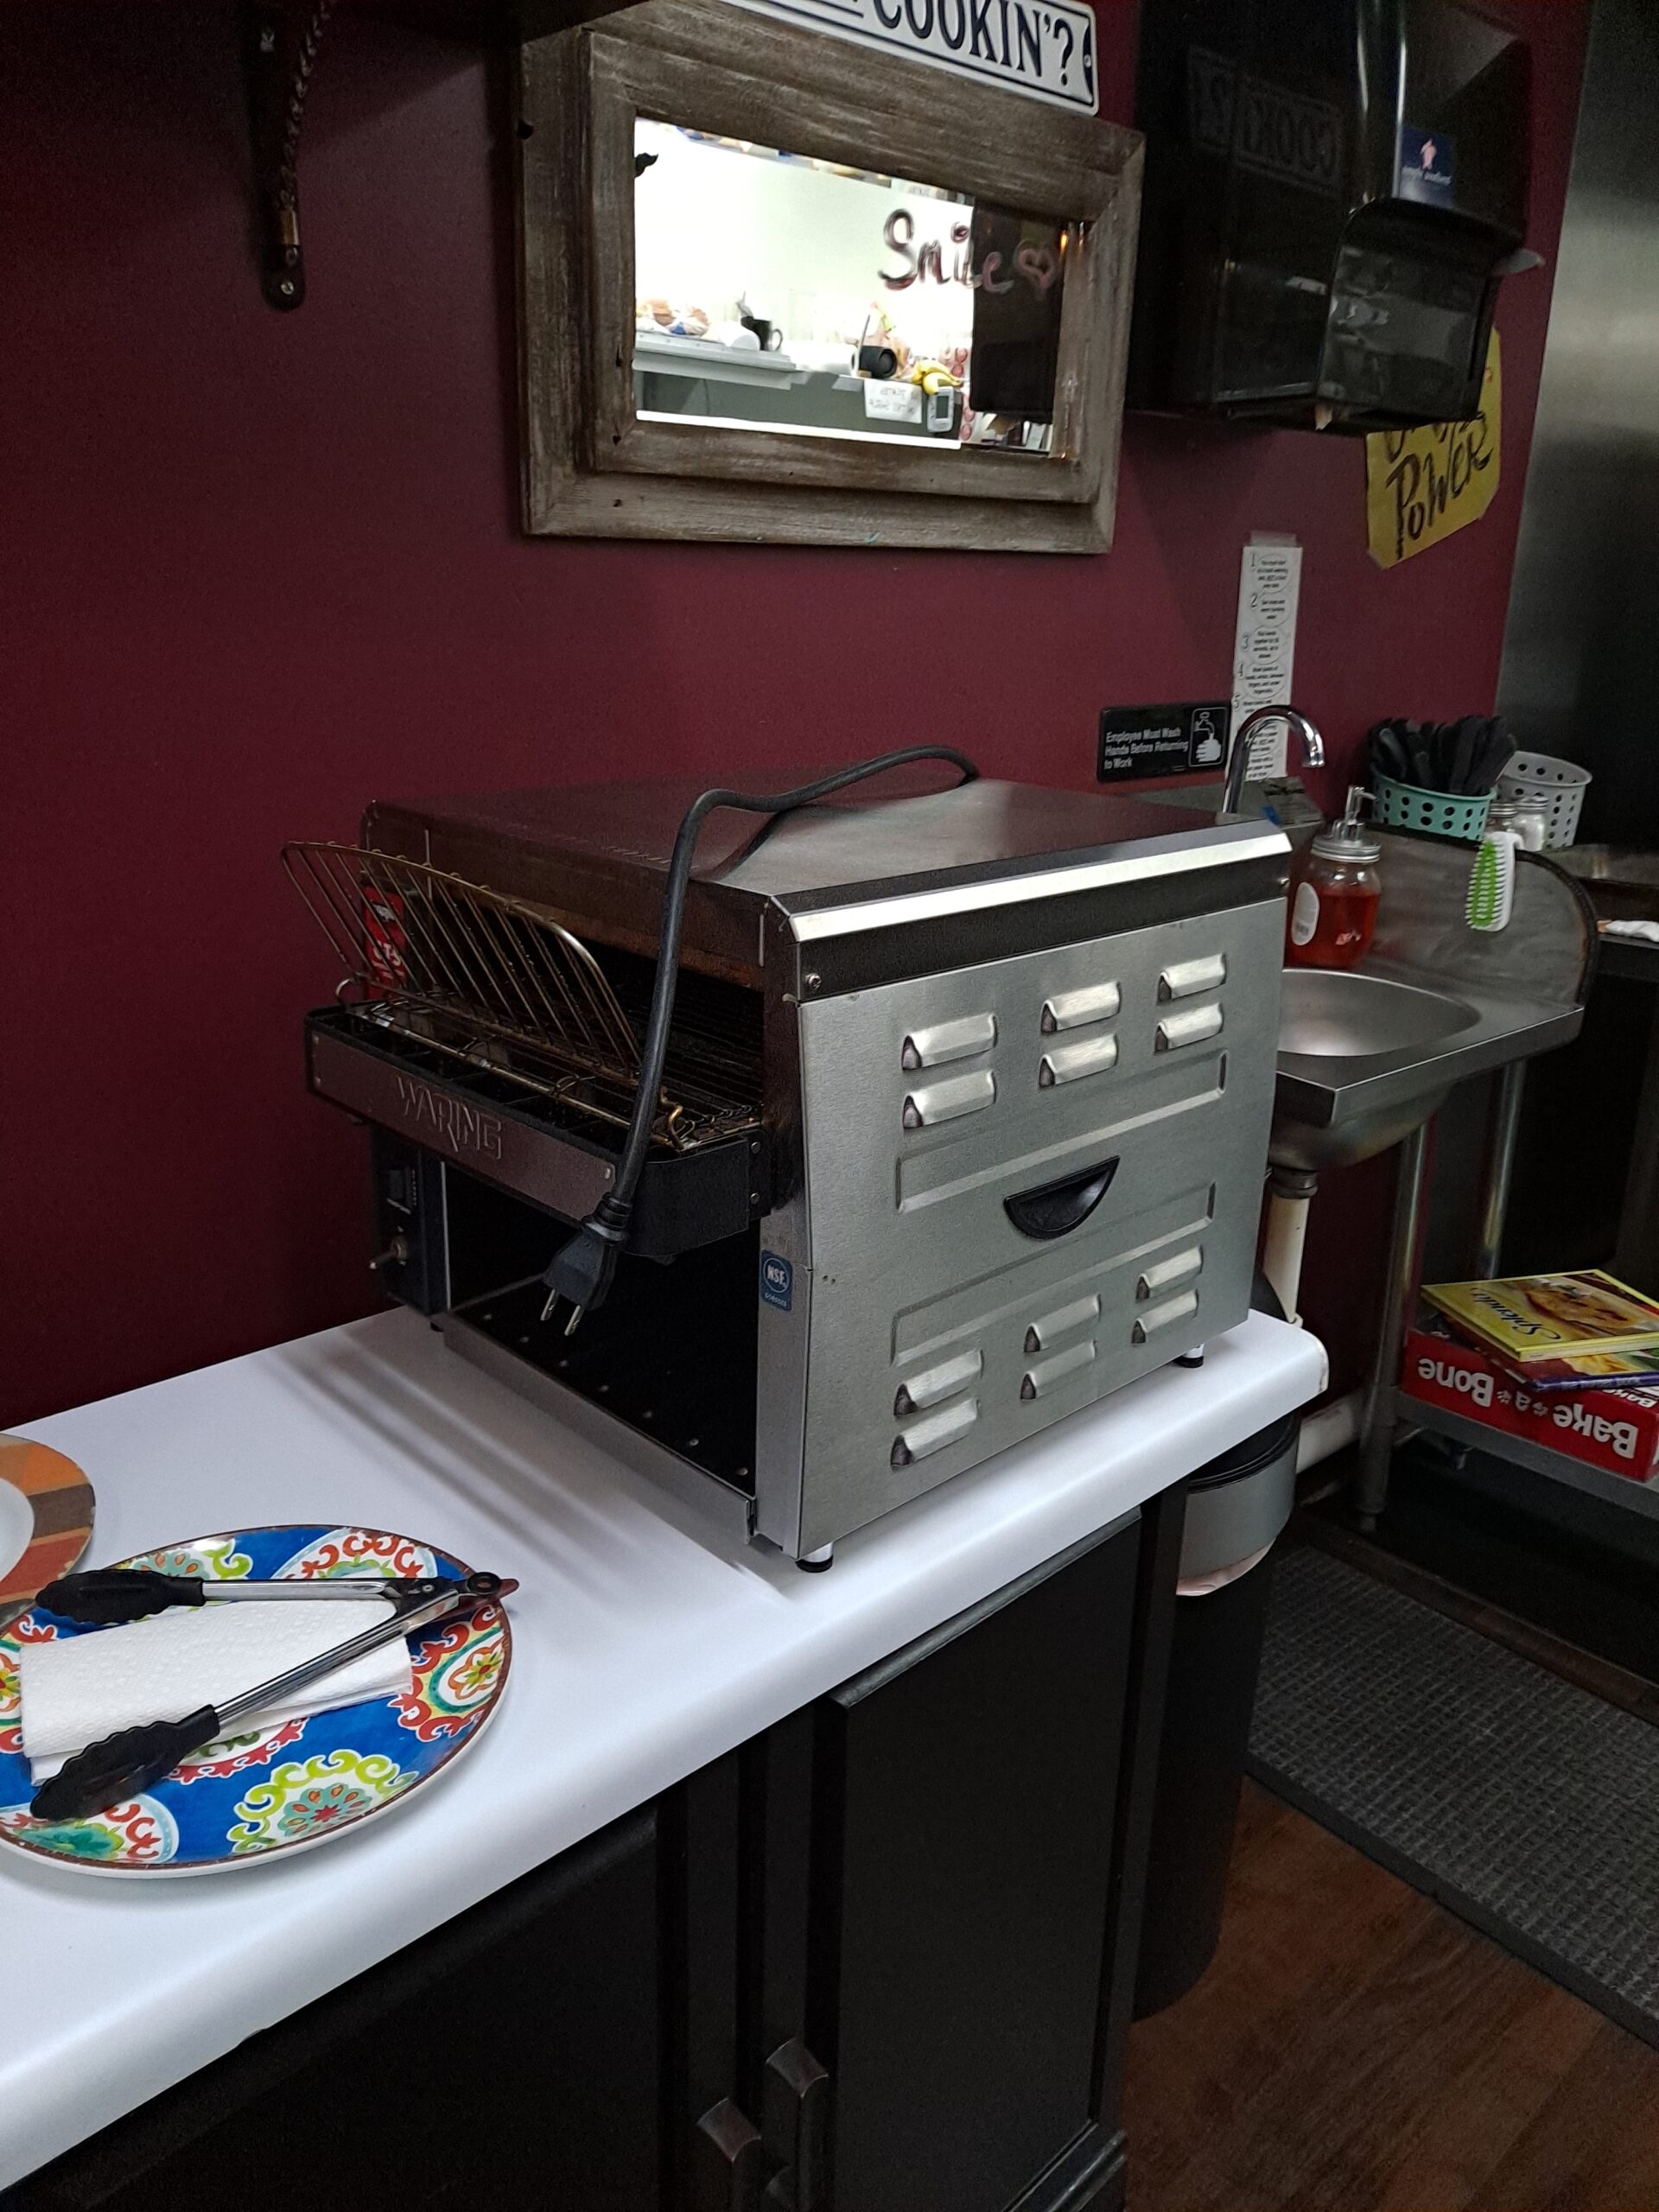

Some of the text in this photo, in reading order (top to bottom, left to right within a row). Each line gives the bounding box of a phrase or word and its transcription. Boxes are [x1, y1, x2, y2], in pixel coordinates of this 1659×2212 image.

[1250, 593, 1258, 608] 2
[1106, 727, 1181, 744] Employee Must Wash
[1105, 740, 1189, 757] Hands Before Returning
[1104, 757, 1134, 771] to Work
[397, 1076, 502, 1160] WARING
[766, 1264, 786, 1287] NSF
[1471, 1287, 1561, 1340] Splenda
[1417, 1357, 1495, 1408] Bone
[1552, 1403, 1639, 1459] Bake
